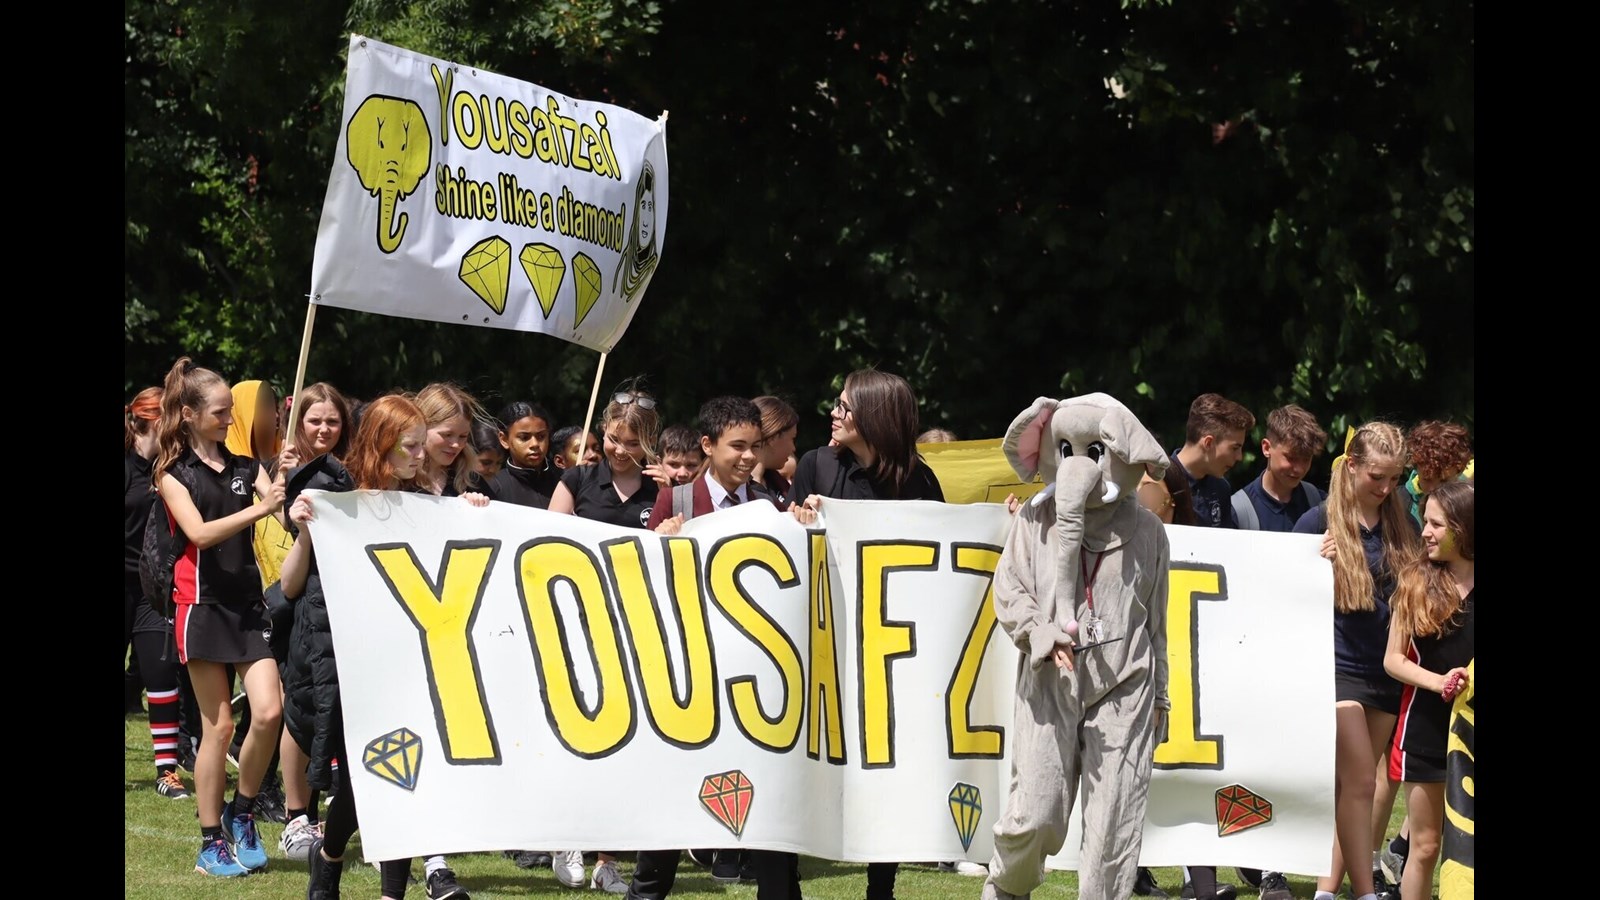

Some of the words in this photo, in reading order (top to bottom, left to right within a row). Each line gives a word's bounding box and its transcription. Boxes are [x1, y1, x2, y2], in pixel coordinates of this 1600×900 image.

[430, 63, 622, 181] Yousafzai
[435, 162, 497, 221] Shine
[498, 172, 538, 228] like
[540, 192, 555, 232] a
[557, 185, 626, 253] diamond
[365, 528, 1229, 770] YOUSAFZI
